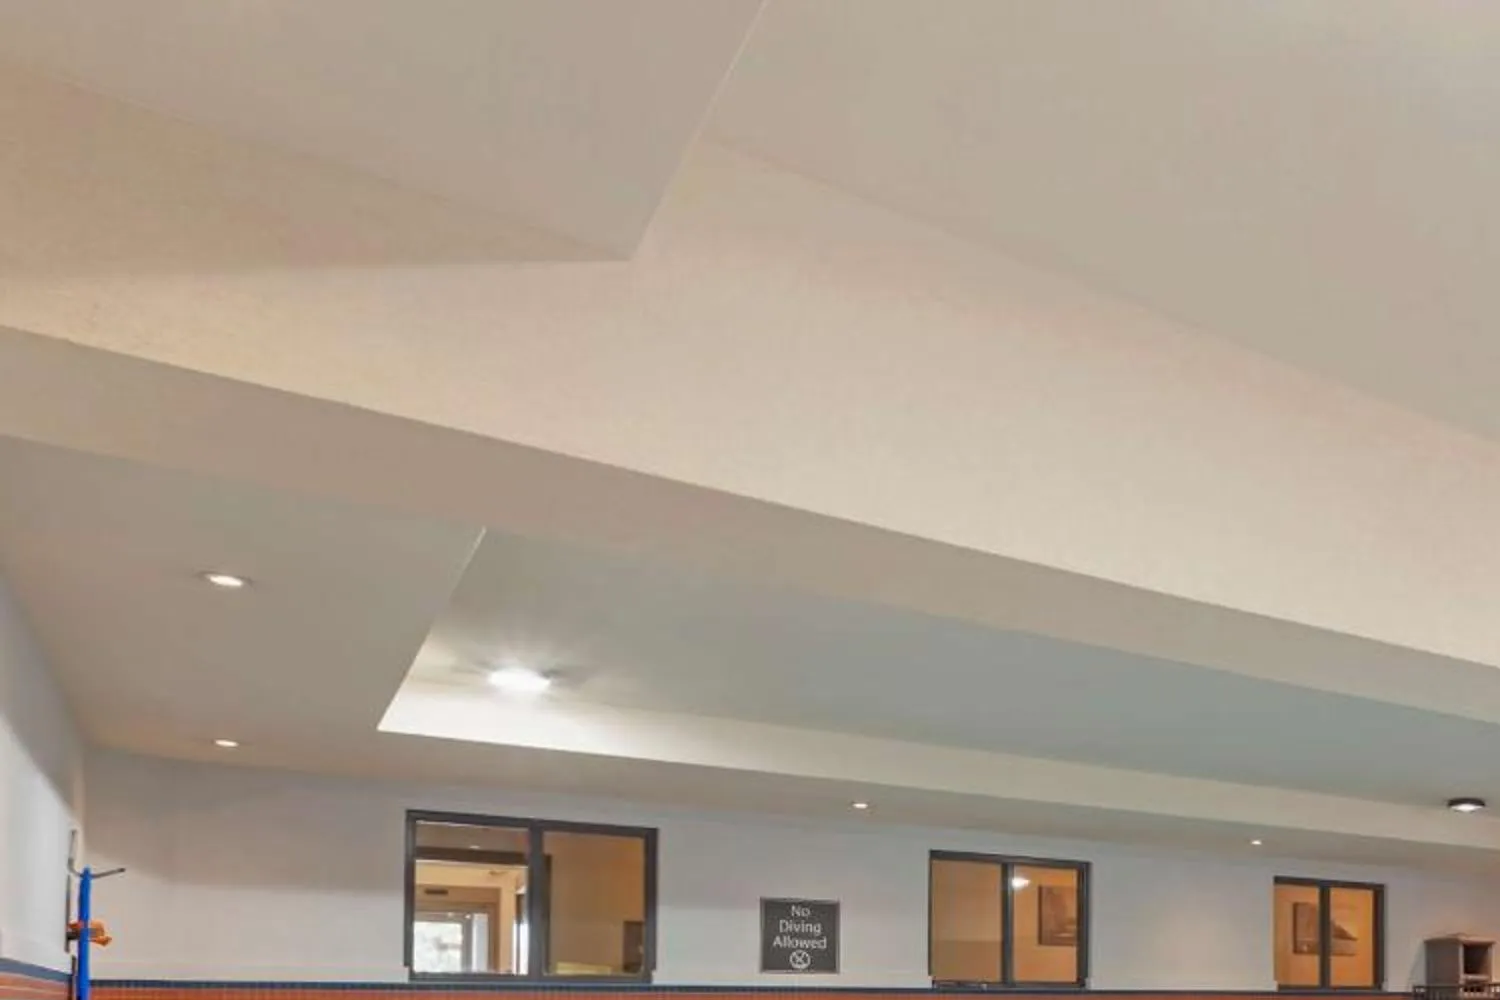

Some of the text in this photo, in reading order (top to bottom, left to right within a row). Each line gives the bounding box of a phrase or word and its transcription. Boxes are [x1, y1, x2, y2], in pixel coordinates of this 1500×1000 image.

[791, 904, 810, 917] No
[779, 919, 821, 937] Diving
[773, 936, 827, 949] Allowed
